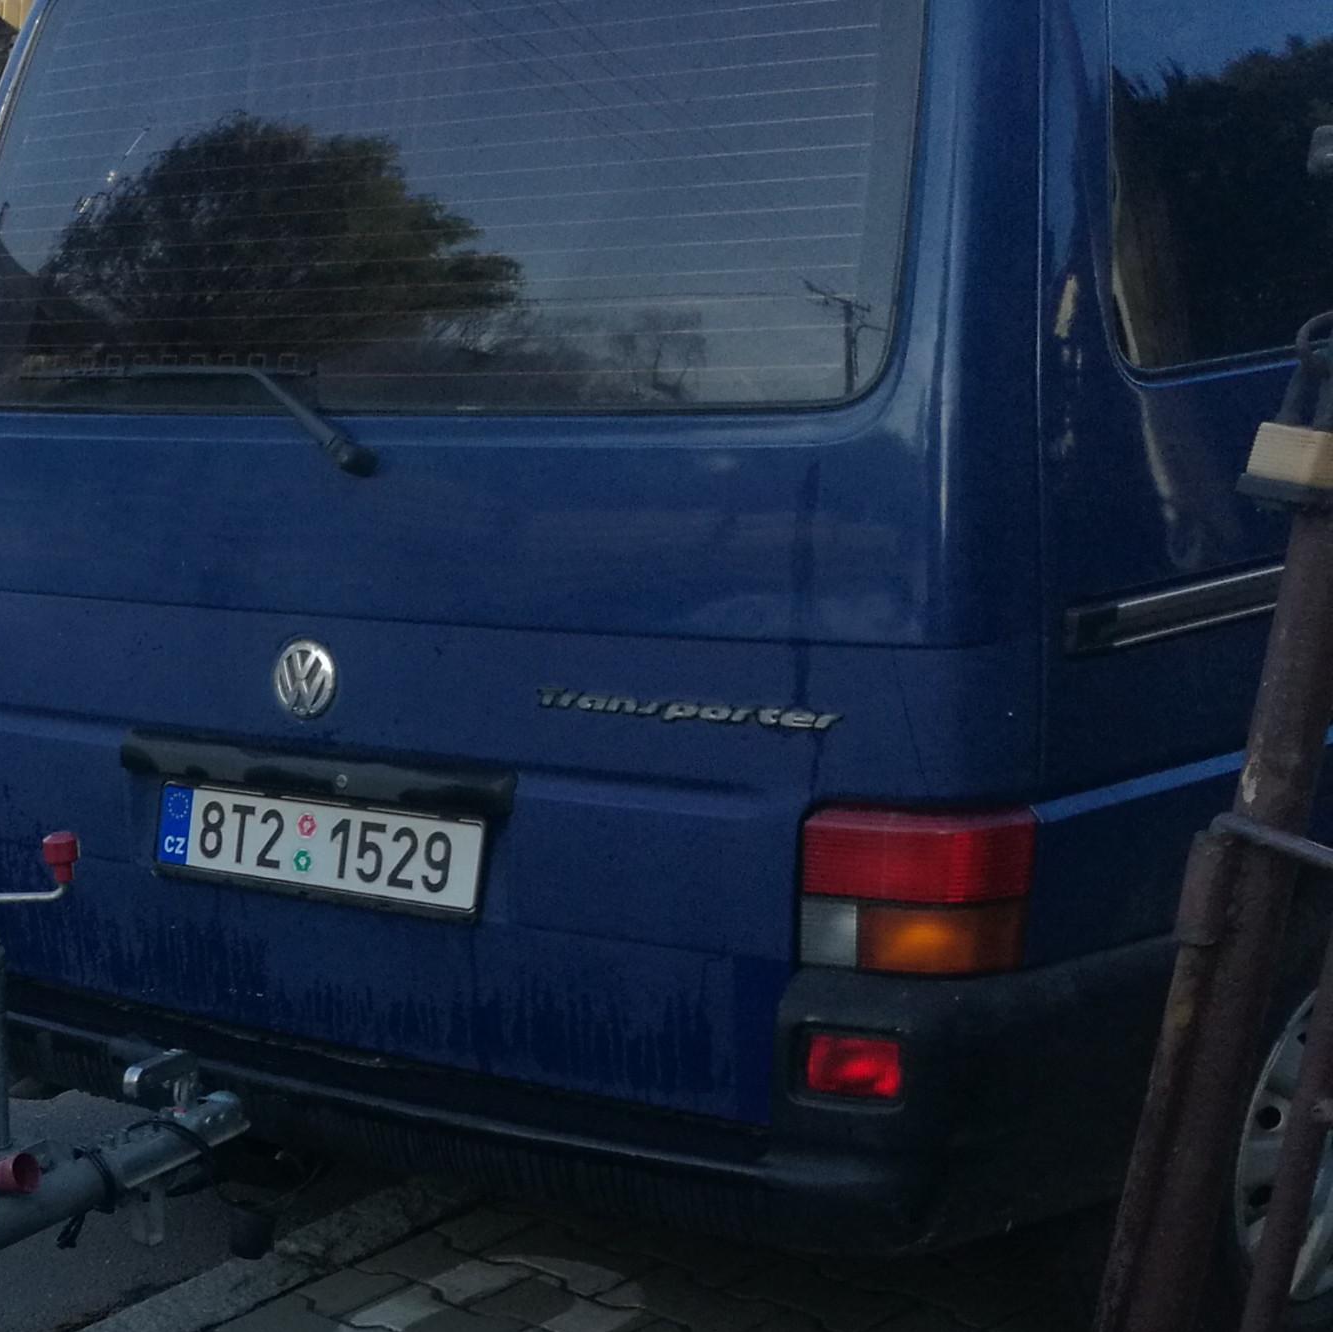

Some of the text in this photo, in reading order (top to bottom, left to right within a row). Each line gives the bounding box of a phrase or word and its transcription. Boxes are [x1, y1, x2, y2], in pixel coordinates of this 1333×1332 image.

[536, 687, 843, 731] Transporter
[163, 832, 186, 856] CZ
[199, 801, 453, 893] 8T2 1529
